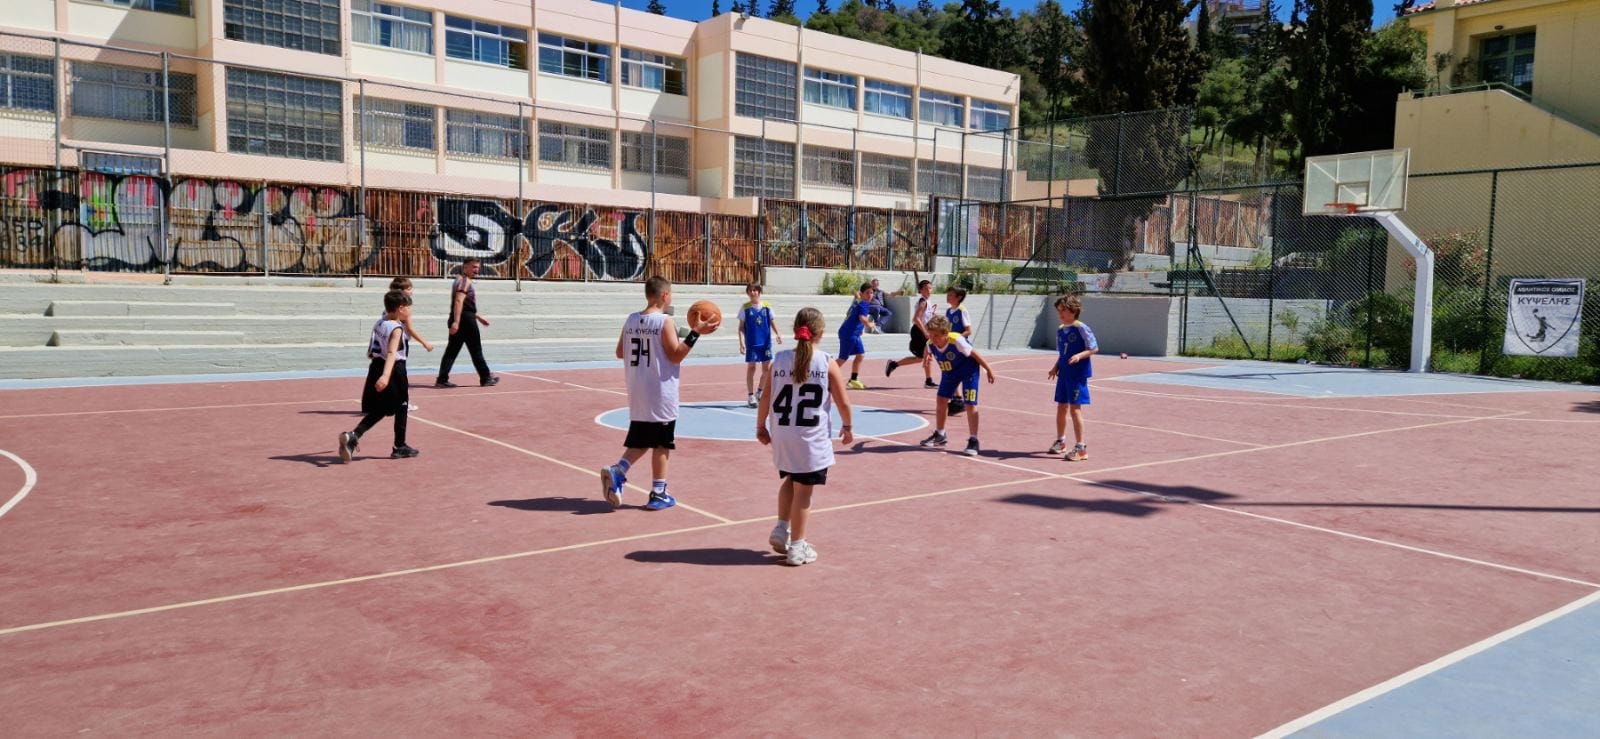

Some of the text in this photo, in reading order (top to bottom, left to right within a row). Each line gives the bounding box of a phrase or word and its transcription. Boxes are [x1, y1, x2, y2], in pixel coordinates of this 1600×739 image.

[1518, 297, 1571, 305] ΚΥΨΕΛΗΣ
[630, 338, 650, 368] 34
[772, 384, 823, 427] 42
[965, 389, 977, 402] 30
